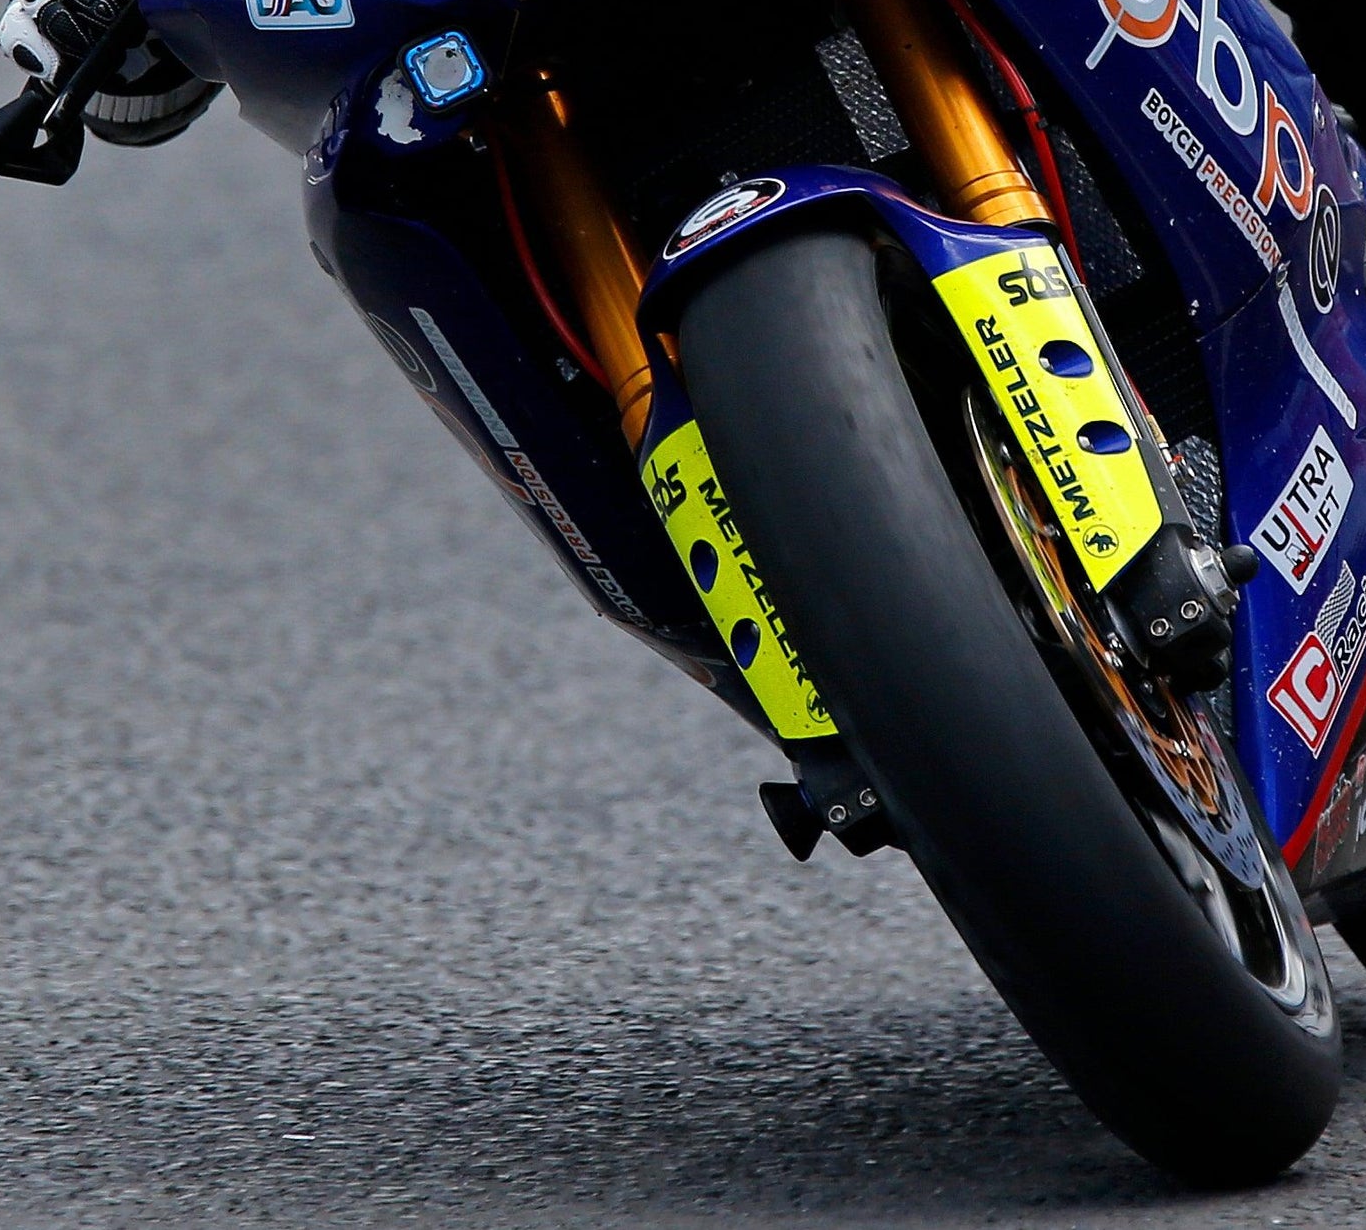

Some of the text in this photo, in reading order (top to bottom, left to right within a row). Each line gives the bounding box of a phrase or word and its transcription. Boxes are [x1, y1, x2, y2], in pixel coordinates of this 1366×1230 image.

[1145, 93, 1201, 163] BOYCE
[1201, 159, 1282, 267] PRECISION
[997, 251, 1072, 307] sbs
[976, 314, 1096, 523] METZELER
[505, 450, 601, 565] PRECISION
[1261, 445, 1335, 554] ULTRA
[1270, 638, 1339, 747] IC
